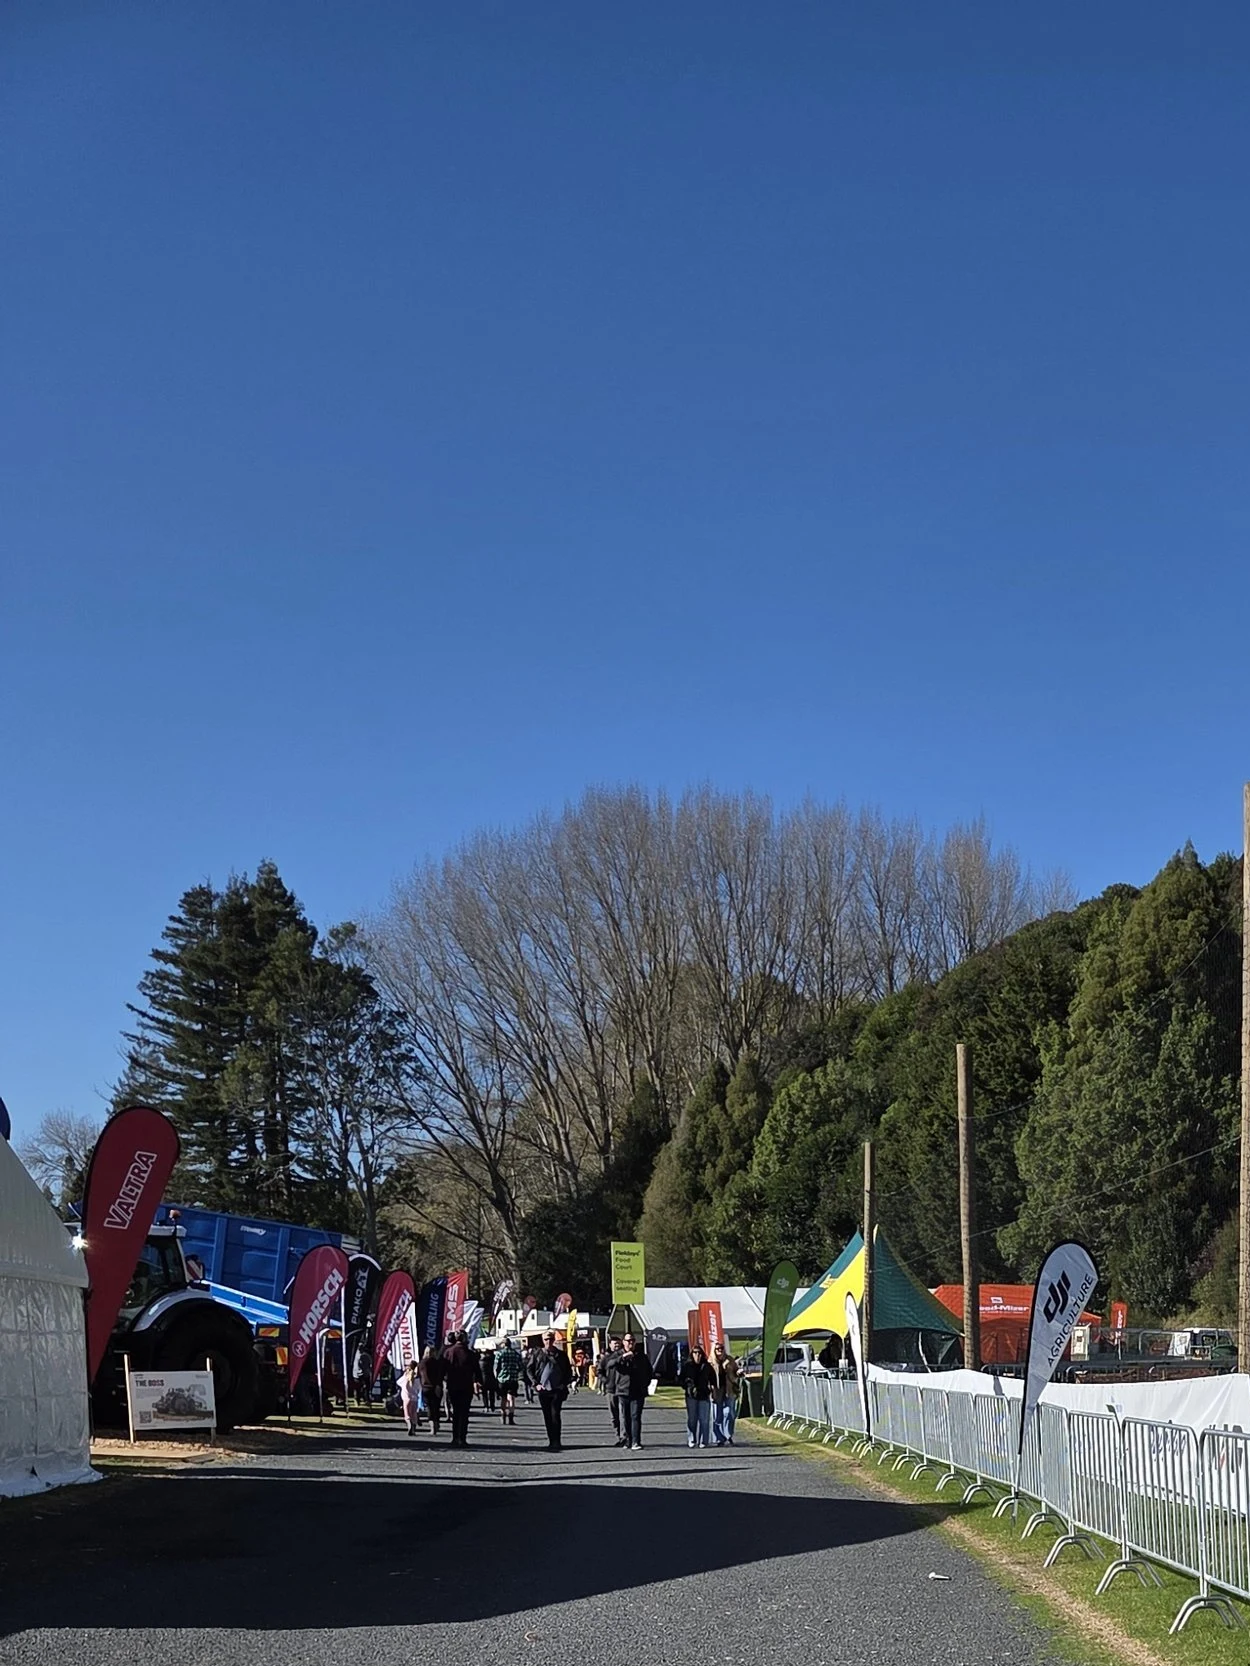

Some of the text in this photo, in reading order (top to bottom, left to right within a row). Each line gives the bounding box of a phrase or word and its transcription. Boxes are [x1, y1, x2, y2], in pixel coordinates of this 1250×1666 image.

[104, 1151, 157, 1229] VALTRA
[299, 1268, 344, 1344] HORSCH
[350, 1288, 363, 1325] PIAKO
[1047, 1273, 1094, 1368] AGRICULTURE
